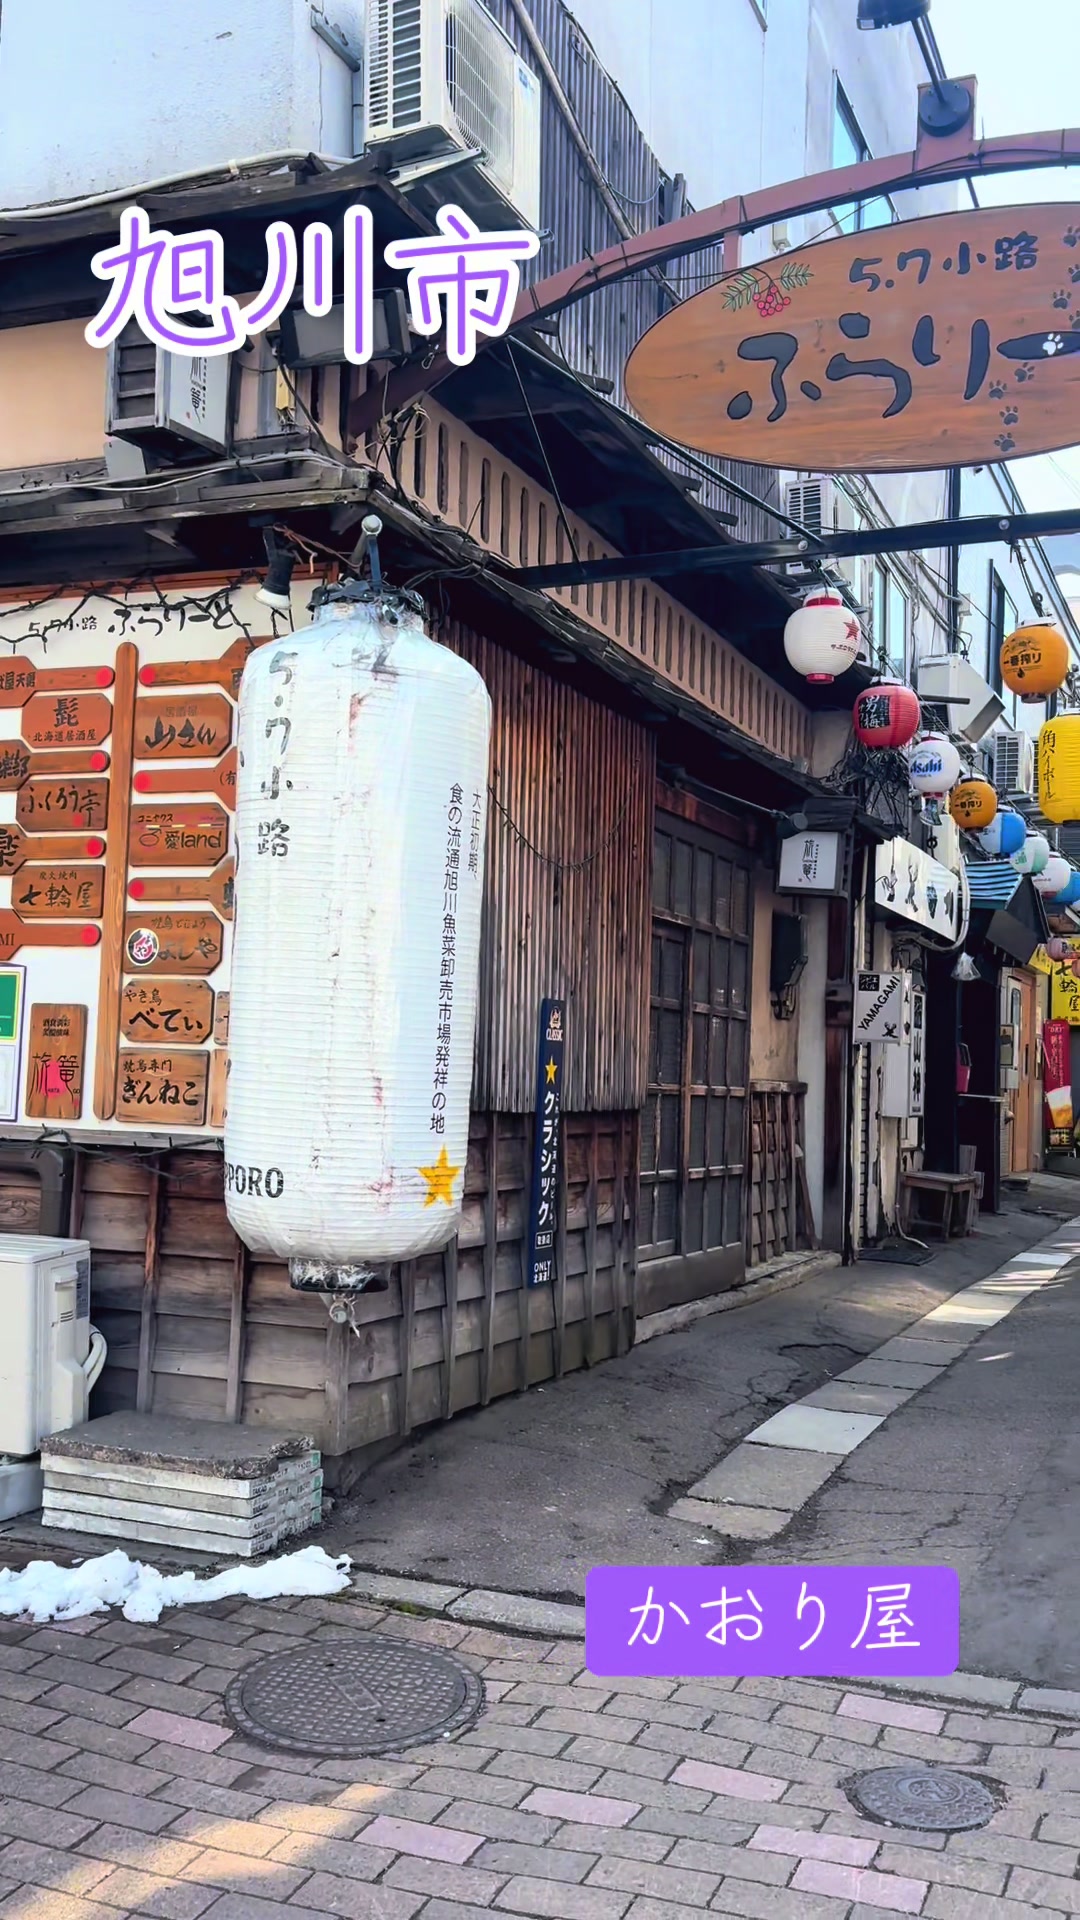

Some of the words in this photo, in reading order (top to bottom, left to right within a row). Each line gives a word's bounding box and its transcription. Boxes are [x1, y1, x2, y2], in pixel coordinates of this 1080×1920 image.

[849, 231, 1039, 292] 5.7小路
[1003, 652, 1042, 667] 一番搾り
[33, 729, 97, 742] 北海道居酒屋
[910, 758, 942, 774] Asahi
[1041, 729, 1057, 801] 角ハイボール
[954, 801, 983, 810] 一番搾り
[164, 830, 223, 850] 愛land
[19, 882, 94, 909] 七輪屋
[430, 782, 464, 1135] 食の流通旭川魚菜卸売市場発祥の地
[1055, 960, 1080, 1012] 七輪屋
[124, 988, 162, 1006] やき鳥
[858, 975, 900, 1031] YAMAGAMI
[546, 1028, 563, 1041] CLASSIC
[122, 1058, 173, 1073] 焼鳥専門
[121, 1076, 200, 1107] ぎんねこ
[537, 1091, 555, 1226] クラシック
[533, 1259, 552, 1273] ONLY
